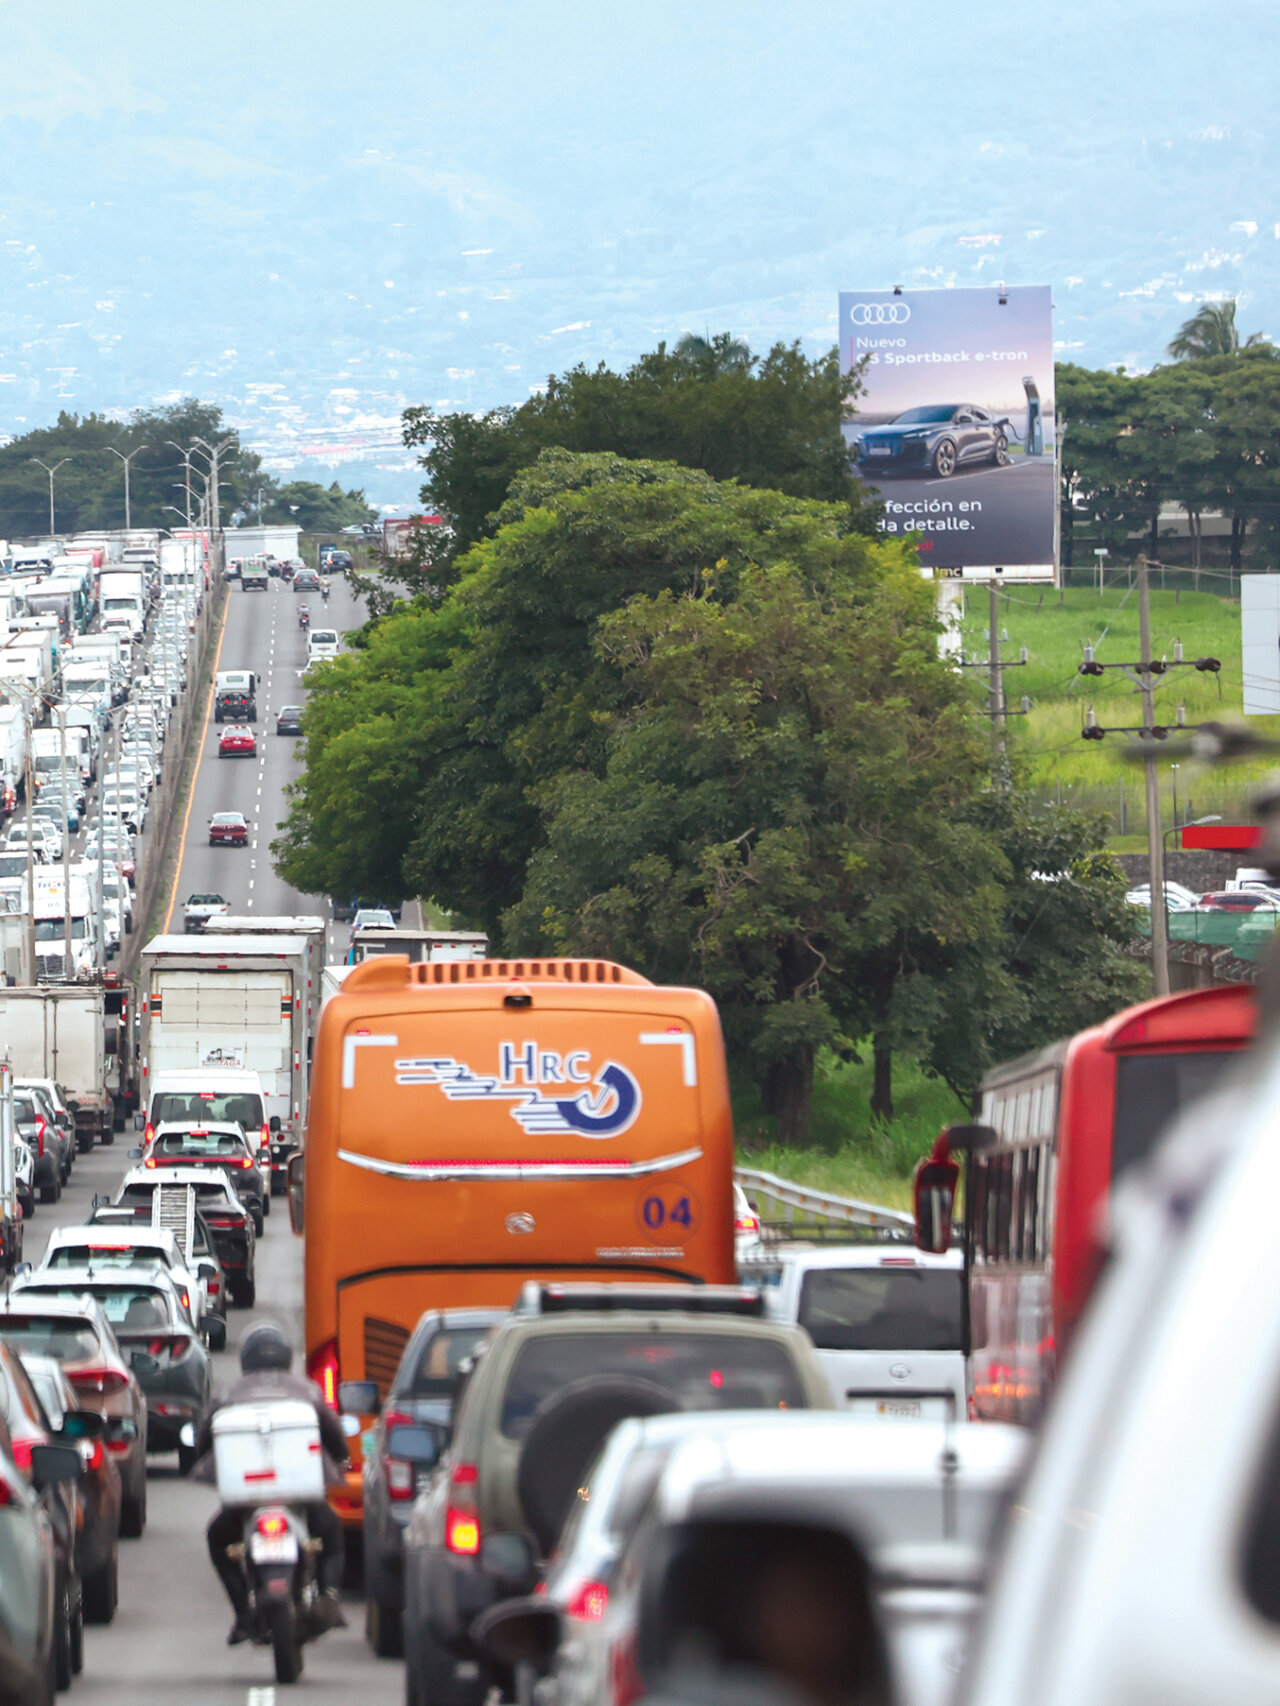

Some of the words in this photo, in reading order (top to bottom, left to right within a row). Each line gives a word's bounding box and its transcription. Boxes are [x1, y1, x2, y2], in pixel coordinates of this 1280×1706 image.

[856, 337, 906, 348] Nuevo
[884, 350, 970, 366] Sportback
[975, 351, 1027, 362] e-tron
[885, 499, 953, 513] fección
[959, 501, 982, 512] en
[876, 519, 898, 532] da
[903, 517, 975, 532] detalle.
[500, 1041, 591, 1084] HRC
[643, 1196, 693, 1229] 04
